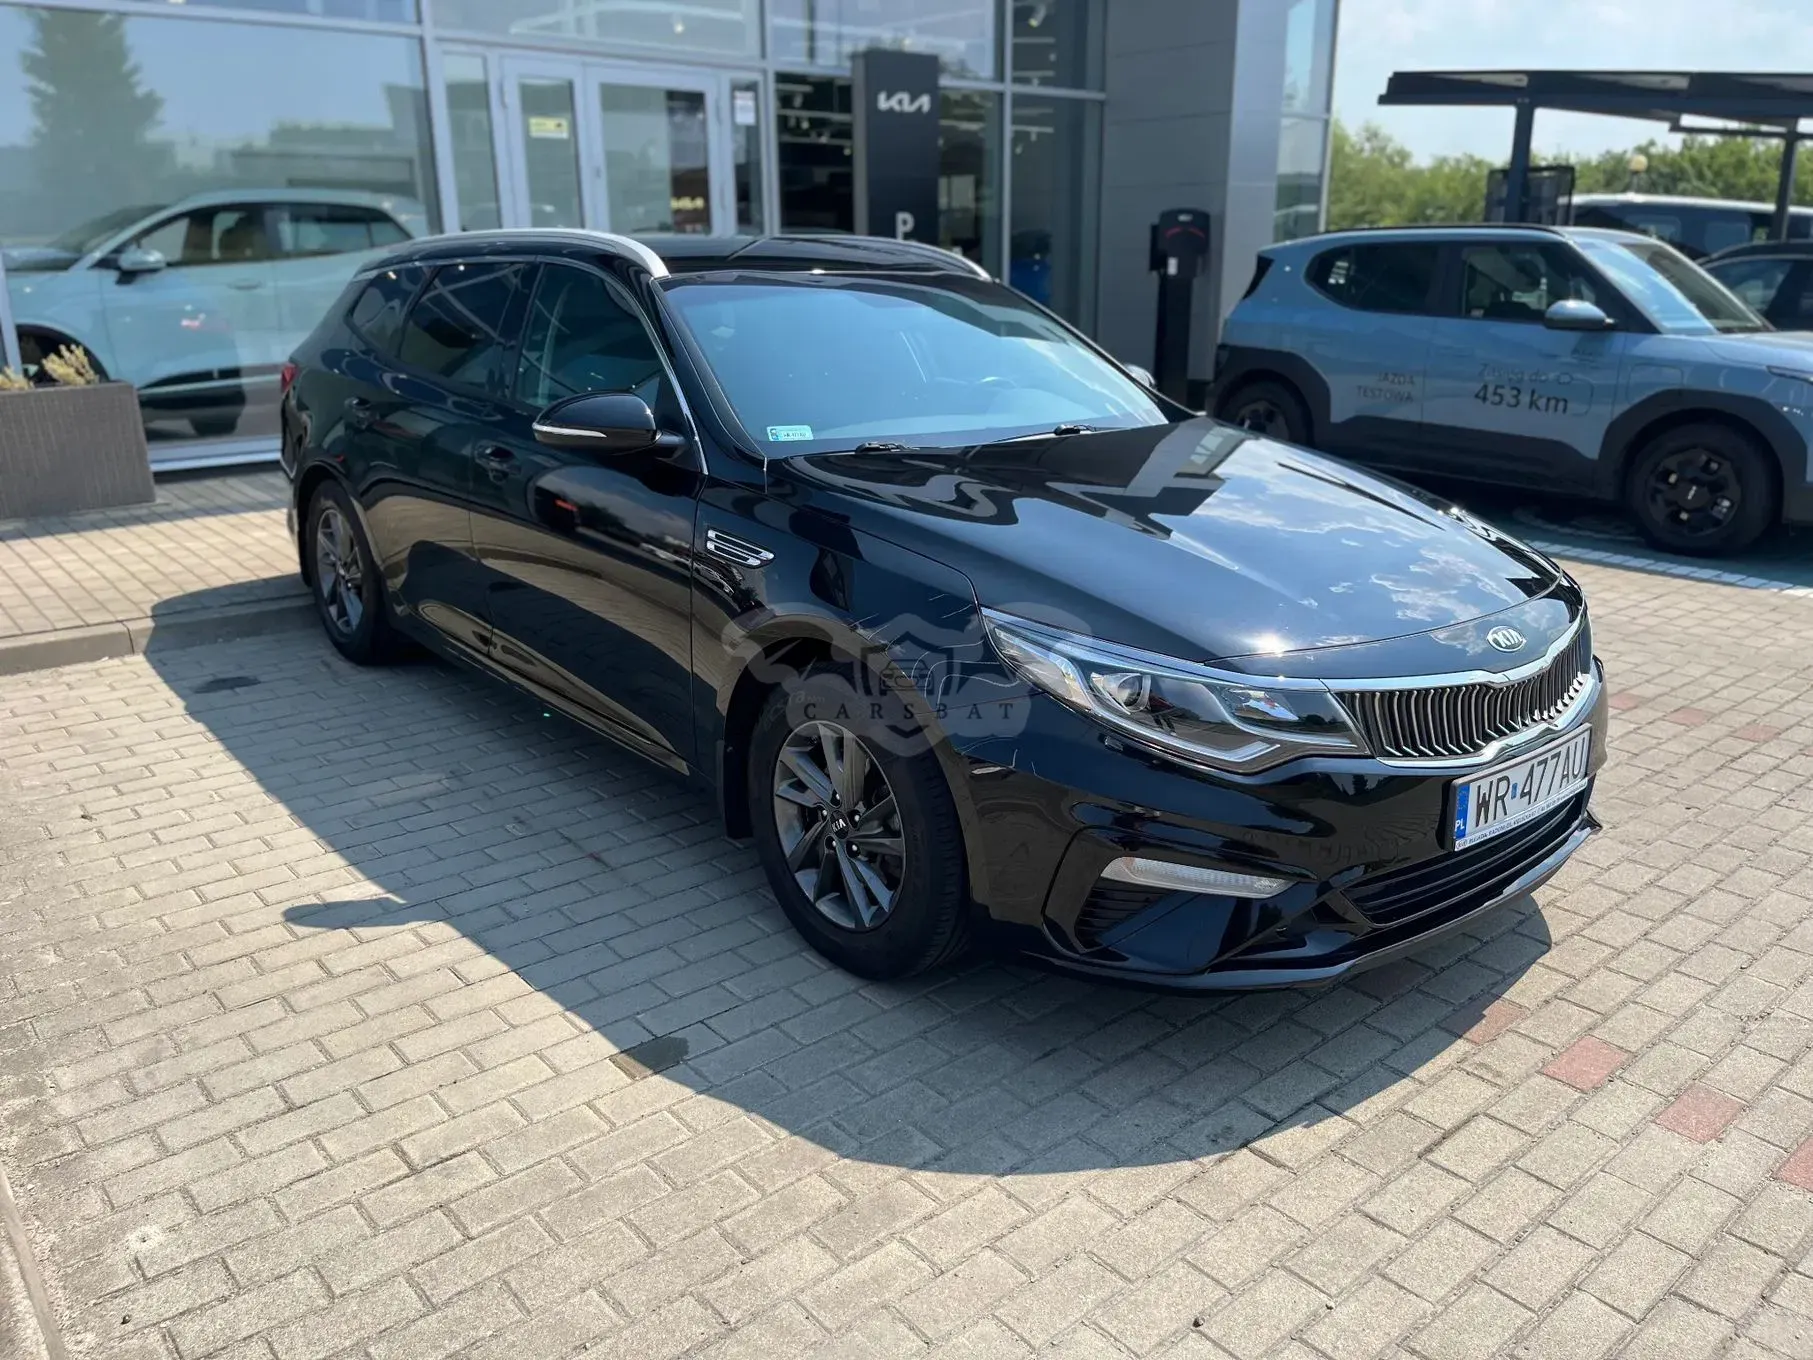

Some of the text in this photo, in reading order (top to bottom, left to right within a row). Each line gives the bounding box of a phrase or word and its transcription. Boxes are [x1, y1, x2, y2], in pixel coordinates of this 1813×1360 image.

[877, 91, 931, 114] KIA
[895, 211, 915, 240] P
[1356, 385, 1415, 403] TESTOWA
[1474, 382, 1569, 415] 453 km
[1492, 628, 1522, 648] KIA
[1475, 776, 1510, 827] WR
[1520, 737, 1585, 805] 477AU
[1455, 818, 1465, 831] PL
